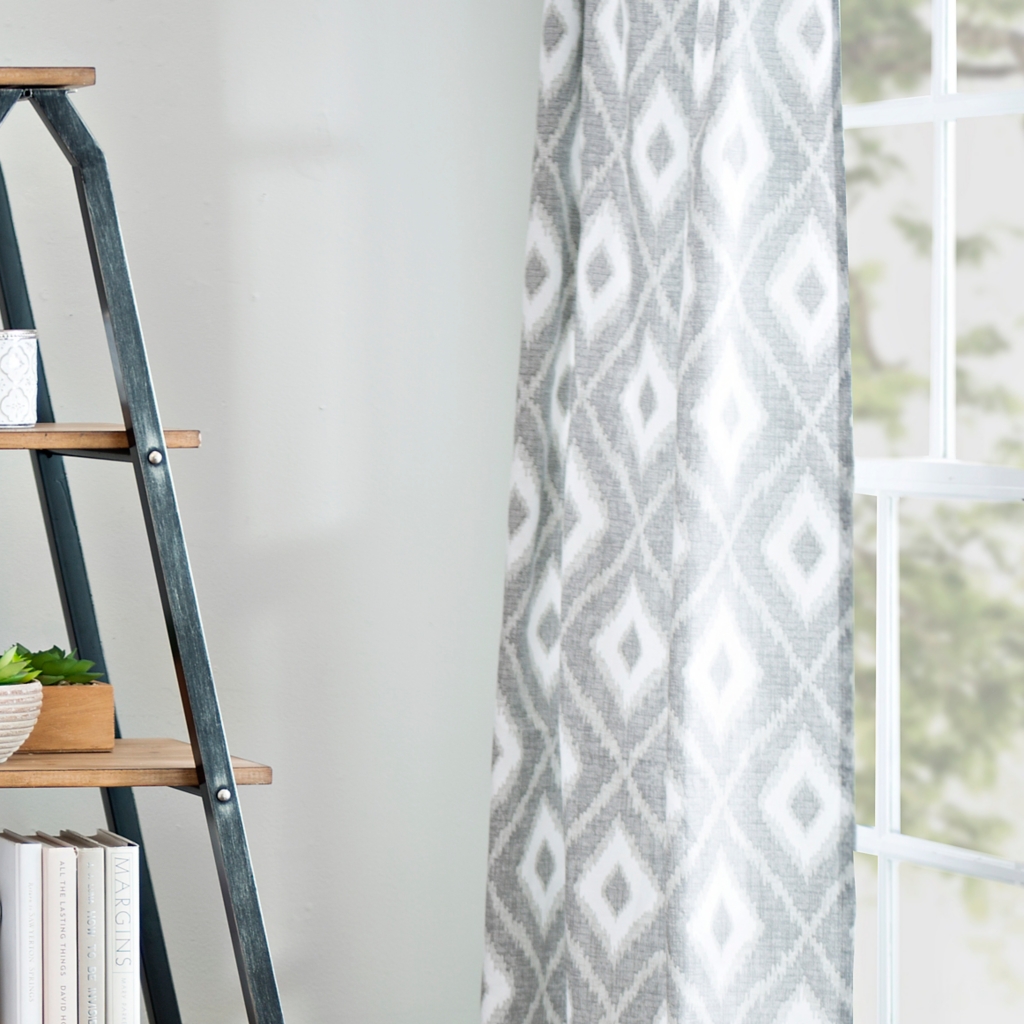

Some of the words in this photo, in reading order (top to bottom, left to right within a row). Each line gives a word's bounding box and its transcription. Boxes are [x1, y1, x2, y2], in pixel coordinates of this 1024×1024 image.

[59, 901, 67, 940] LASTING
[86, 910, 97, 937] HOW
[114, 857, 132, 967] MARGINS
[87, 944, 97, 959] TO
[28, 967, 36, 1003] SPRINGS
